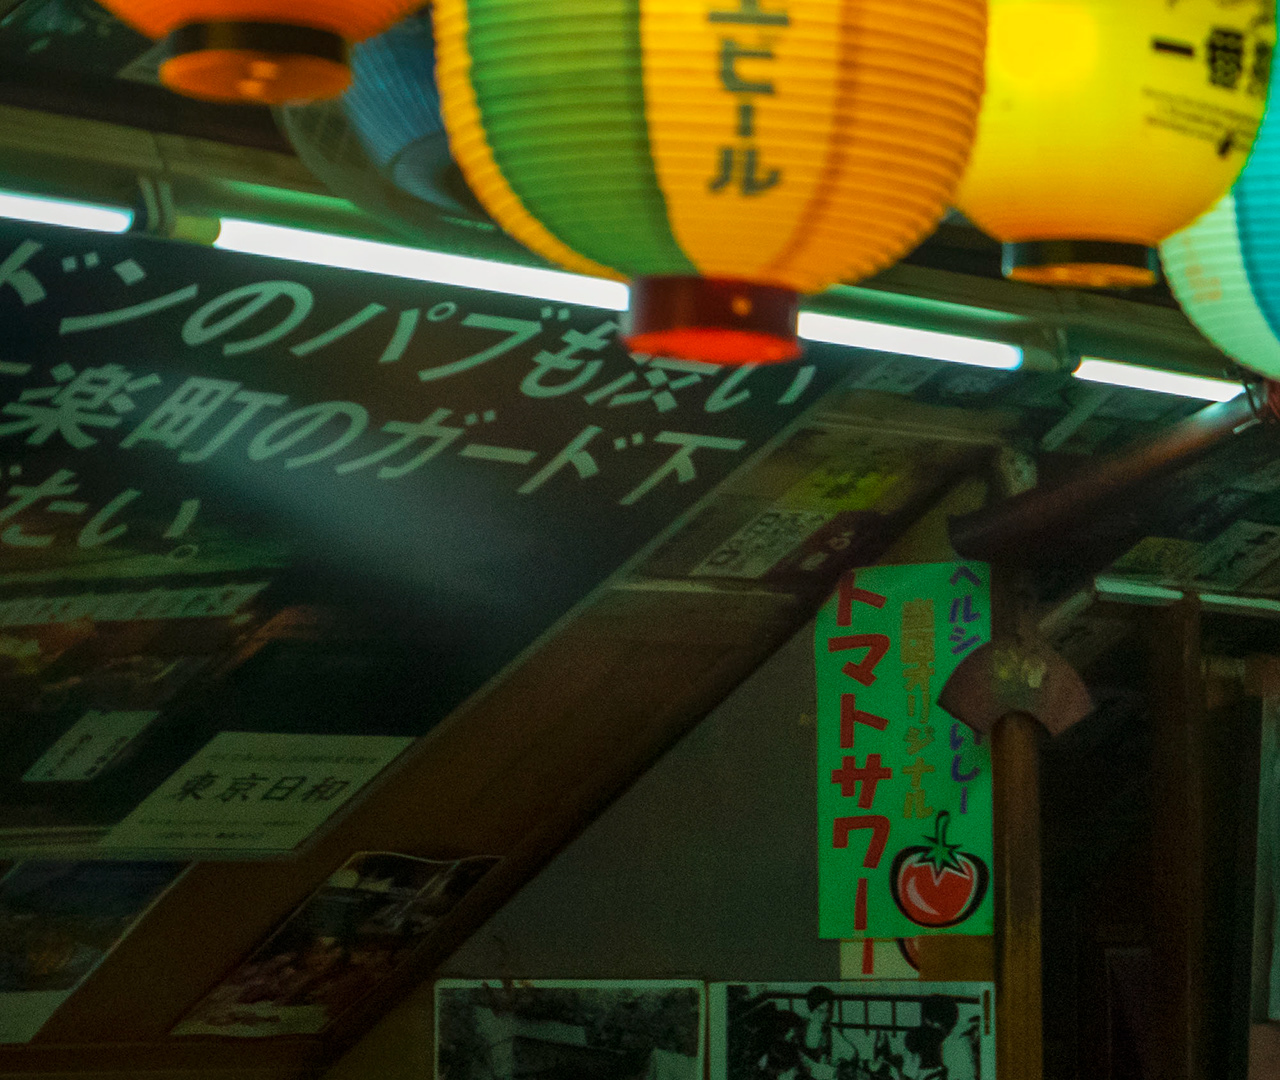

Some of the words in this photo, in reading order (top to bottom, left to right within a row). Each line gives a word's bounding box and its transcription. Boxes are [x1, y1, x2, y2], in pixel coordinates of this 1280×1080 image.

[0, 361, 747, 505] 楽町のガード下
[0, 463, 200, 561] たい。
[172, 770, 350, 803] 東京日和
[827, 569, 893, 930] トマトサワー
